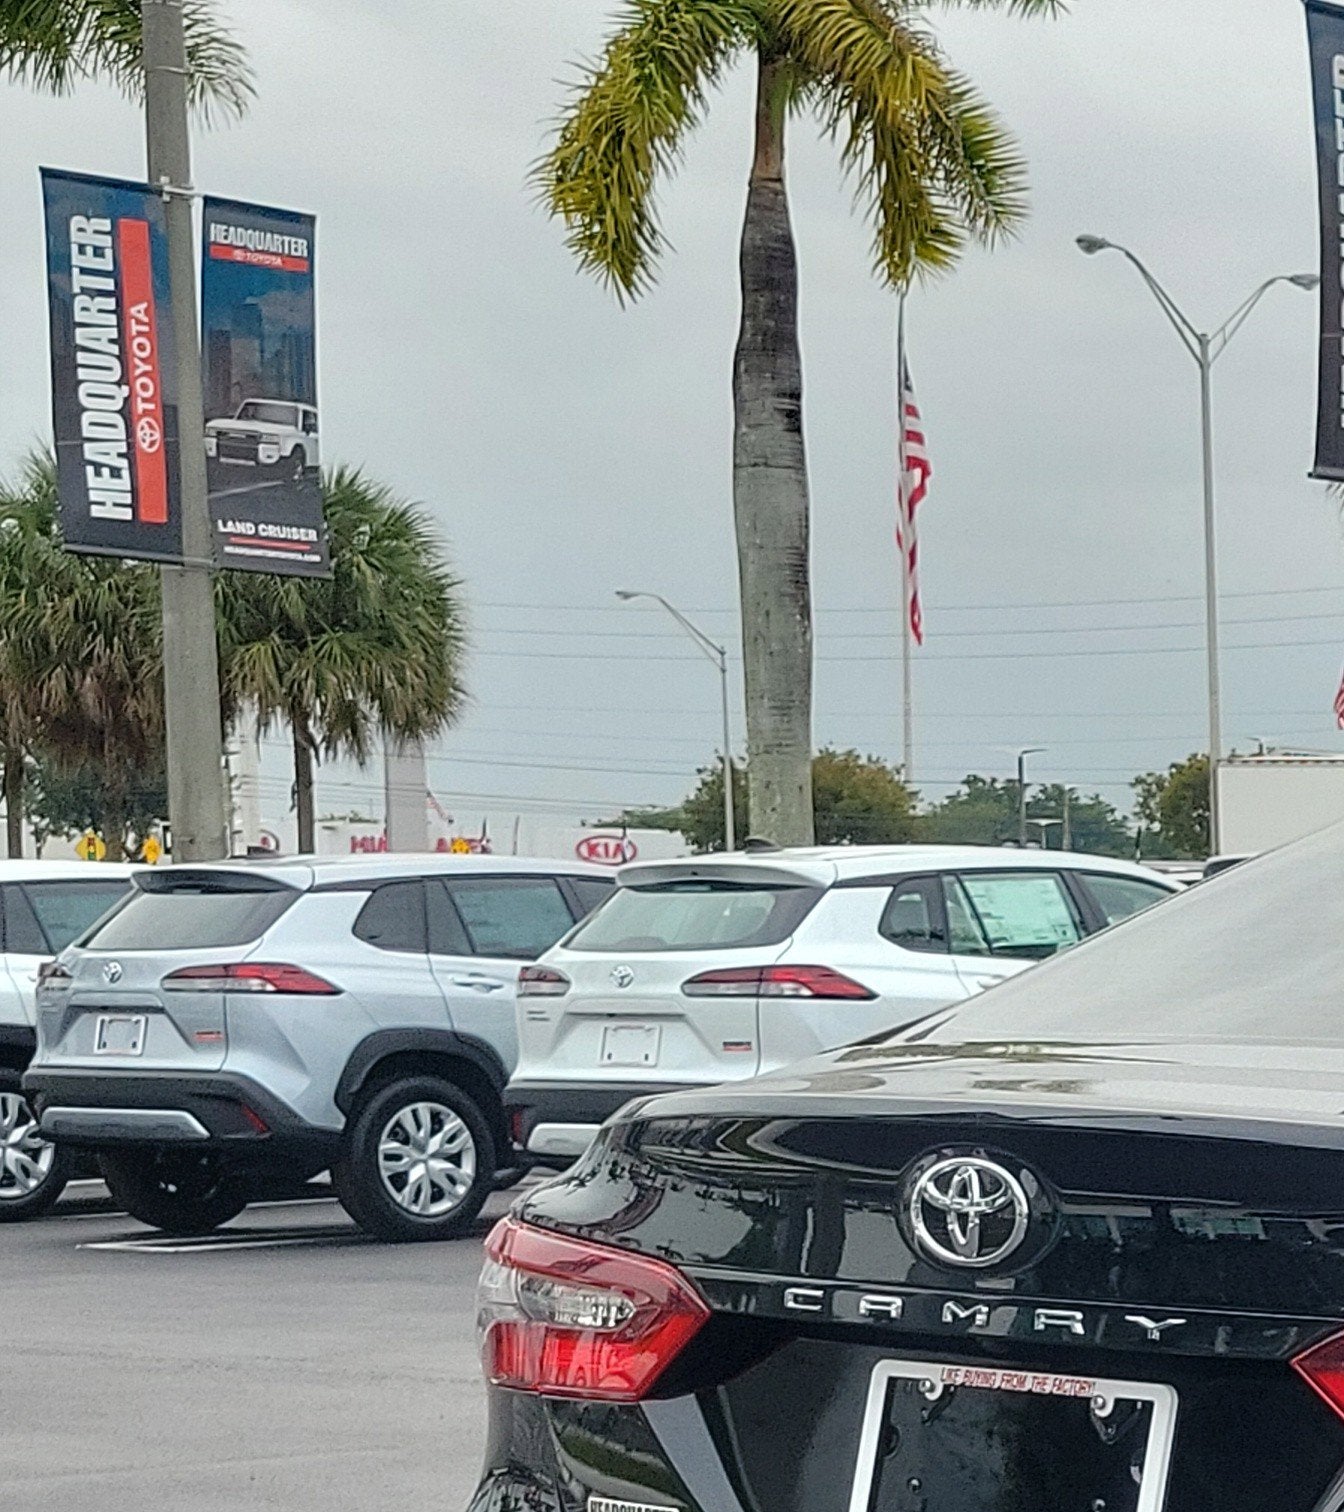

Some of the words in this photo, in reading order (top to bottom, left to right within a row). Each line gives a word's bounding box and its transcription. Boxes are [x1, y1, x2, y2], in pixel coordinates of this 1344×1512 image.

[210, 222, 309, 258] HEADQUARTER
[70, 214, 133, 521] HEADQUARTER
[133, 302, 162, 415] TOYOTA
[217, 519, 256, 536] LAND
[257, 522, 318, 543] CRUISER
[784, 1287, 1188, 1341] CAMRY
